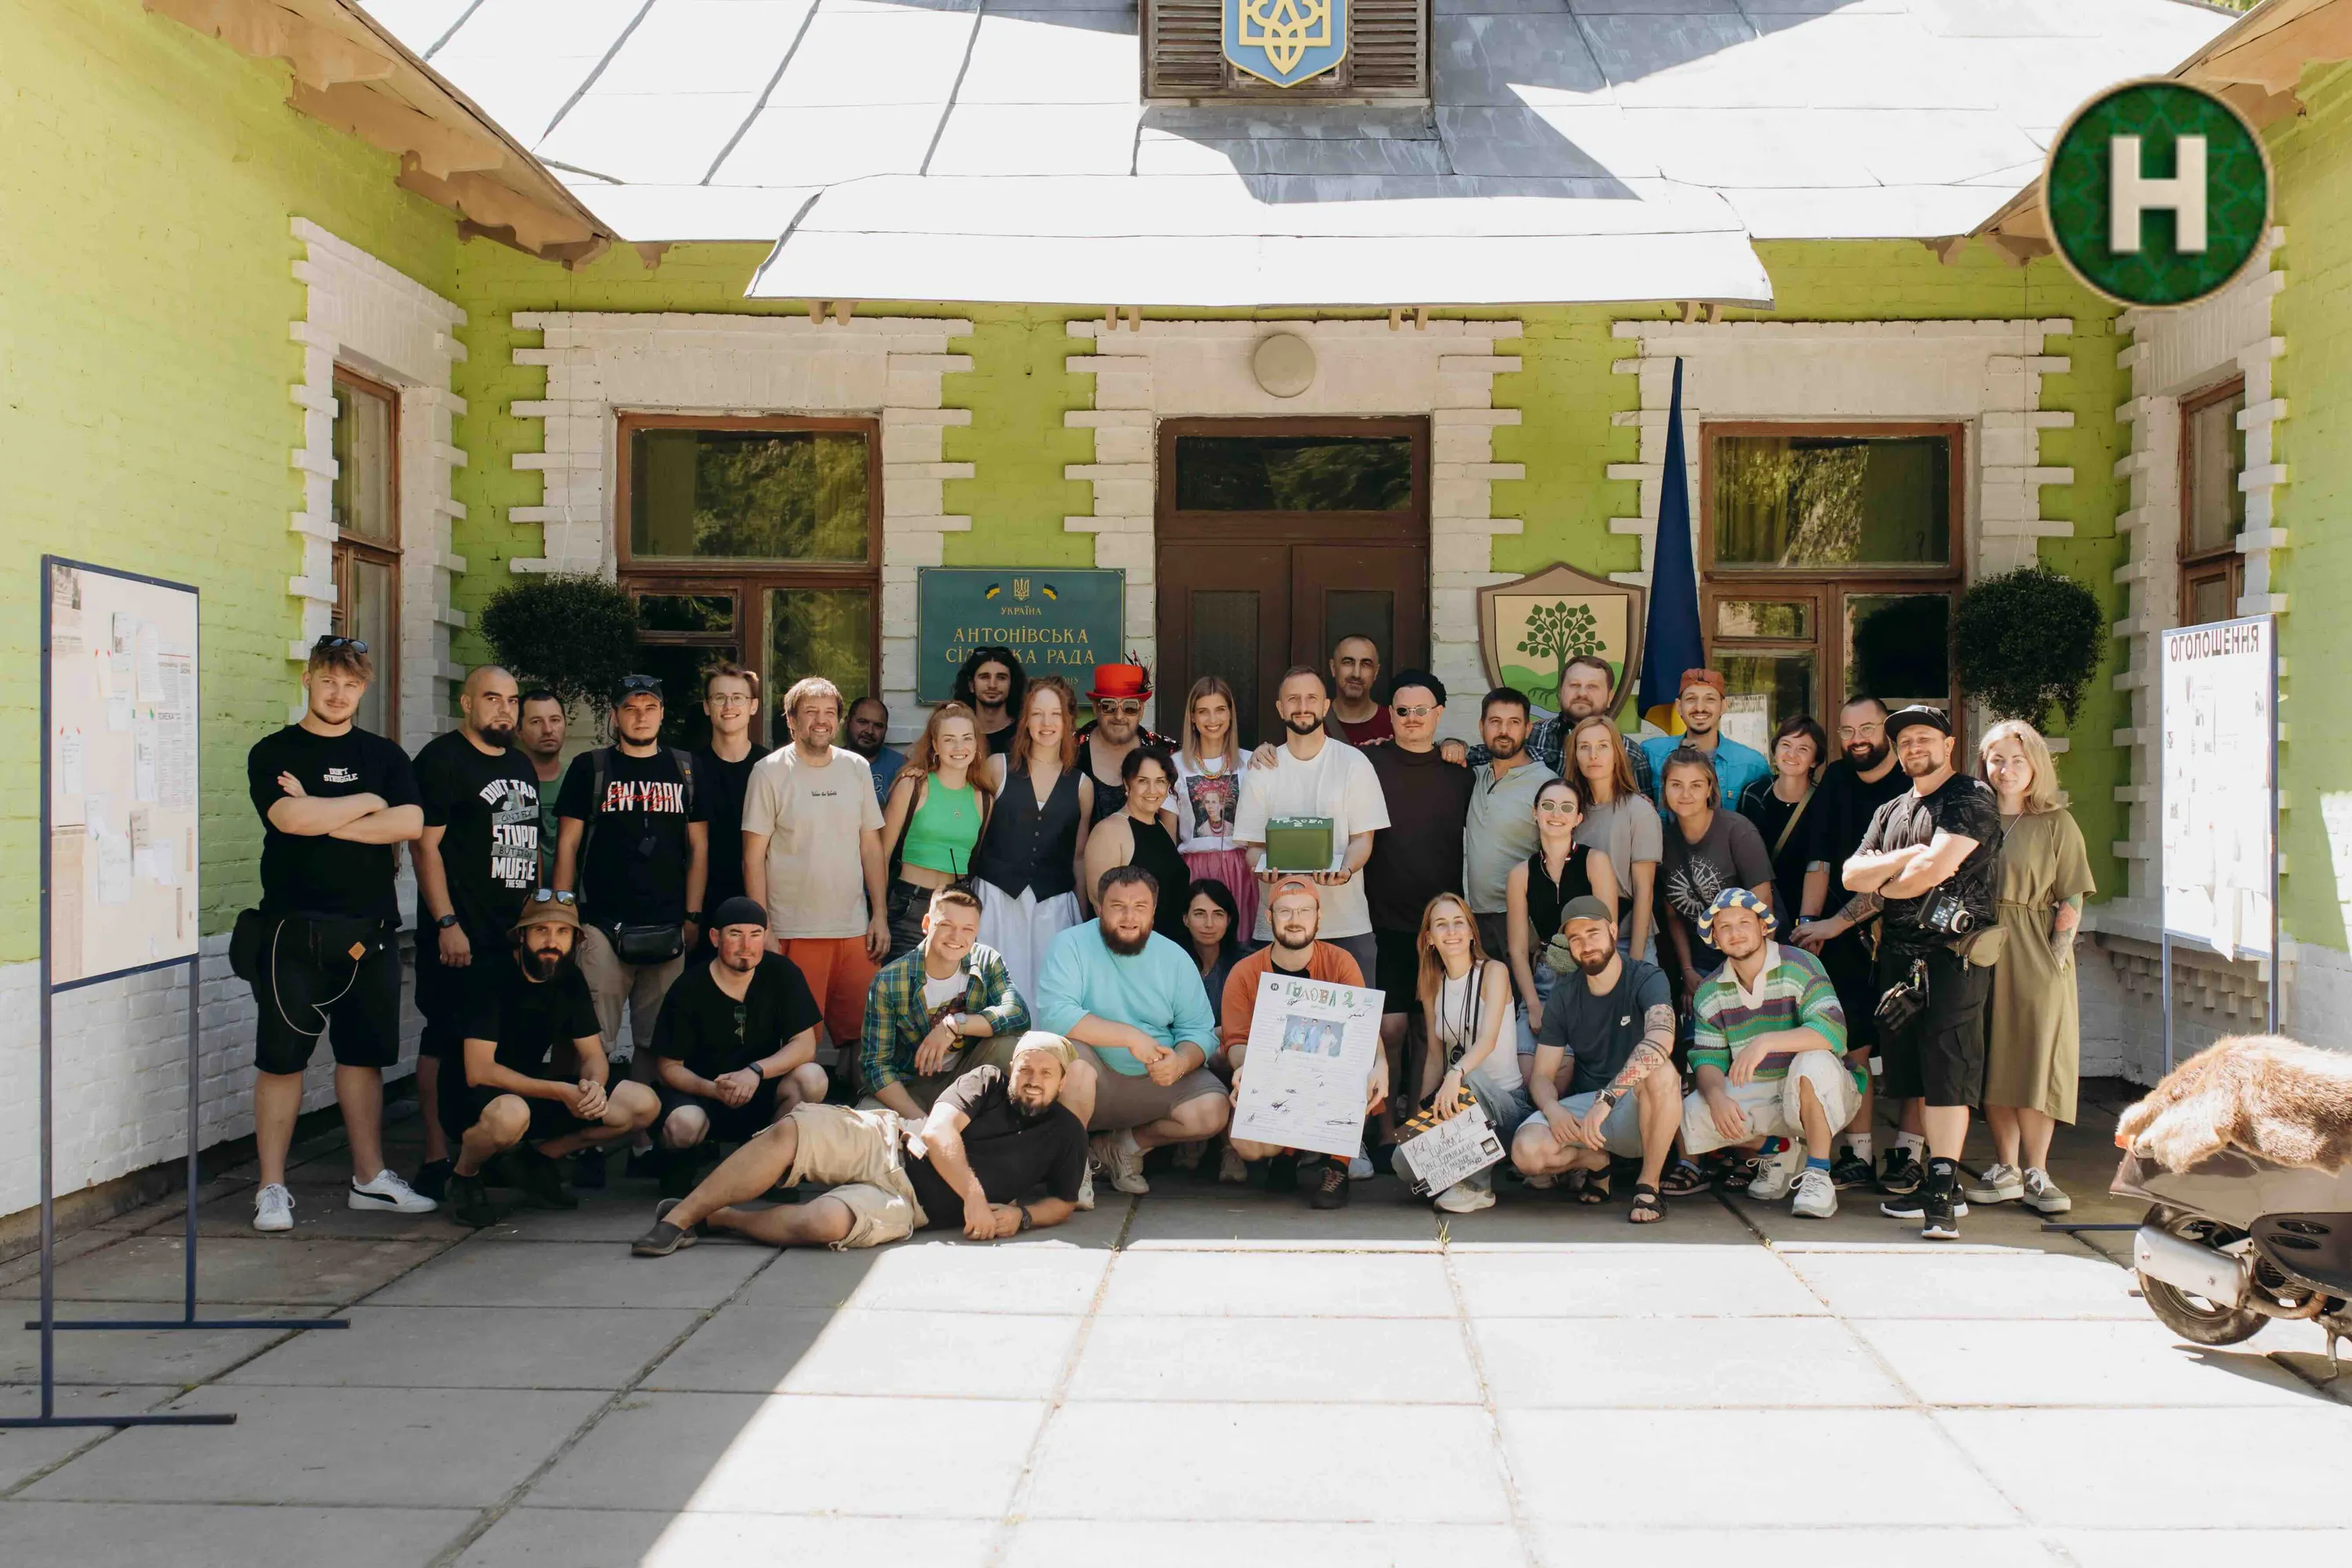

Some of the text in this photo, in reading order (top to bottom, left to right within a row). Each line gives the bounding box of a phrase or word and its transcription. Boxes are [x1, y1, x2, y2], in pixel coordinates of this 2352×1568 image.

[1000, 606, 1042, 615] УКРАЇНА
[953, 626, 1088, 644] АНТОНІВСЬКА
[2171, 625, 2259, 662] ОГОЛОШЕННЯ
[946, 646, 1095, 665] СІЛКА РАДА
[510, 779, 539, 806] TAP
[639, 781, 684, 814] YORK
[1342, 990, 1355, 1008] 2
